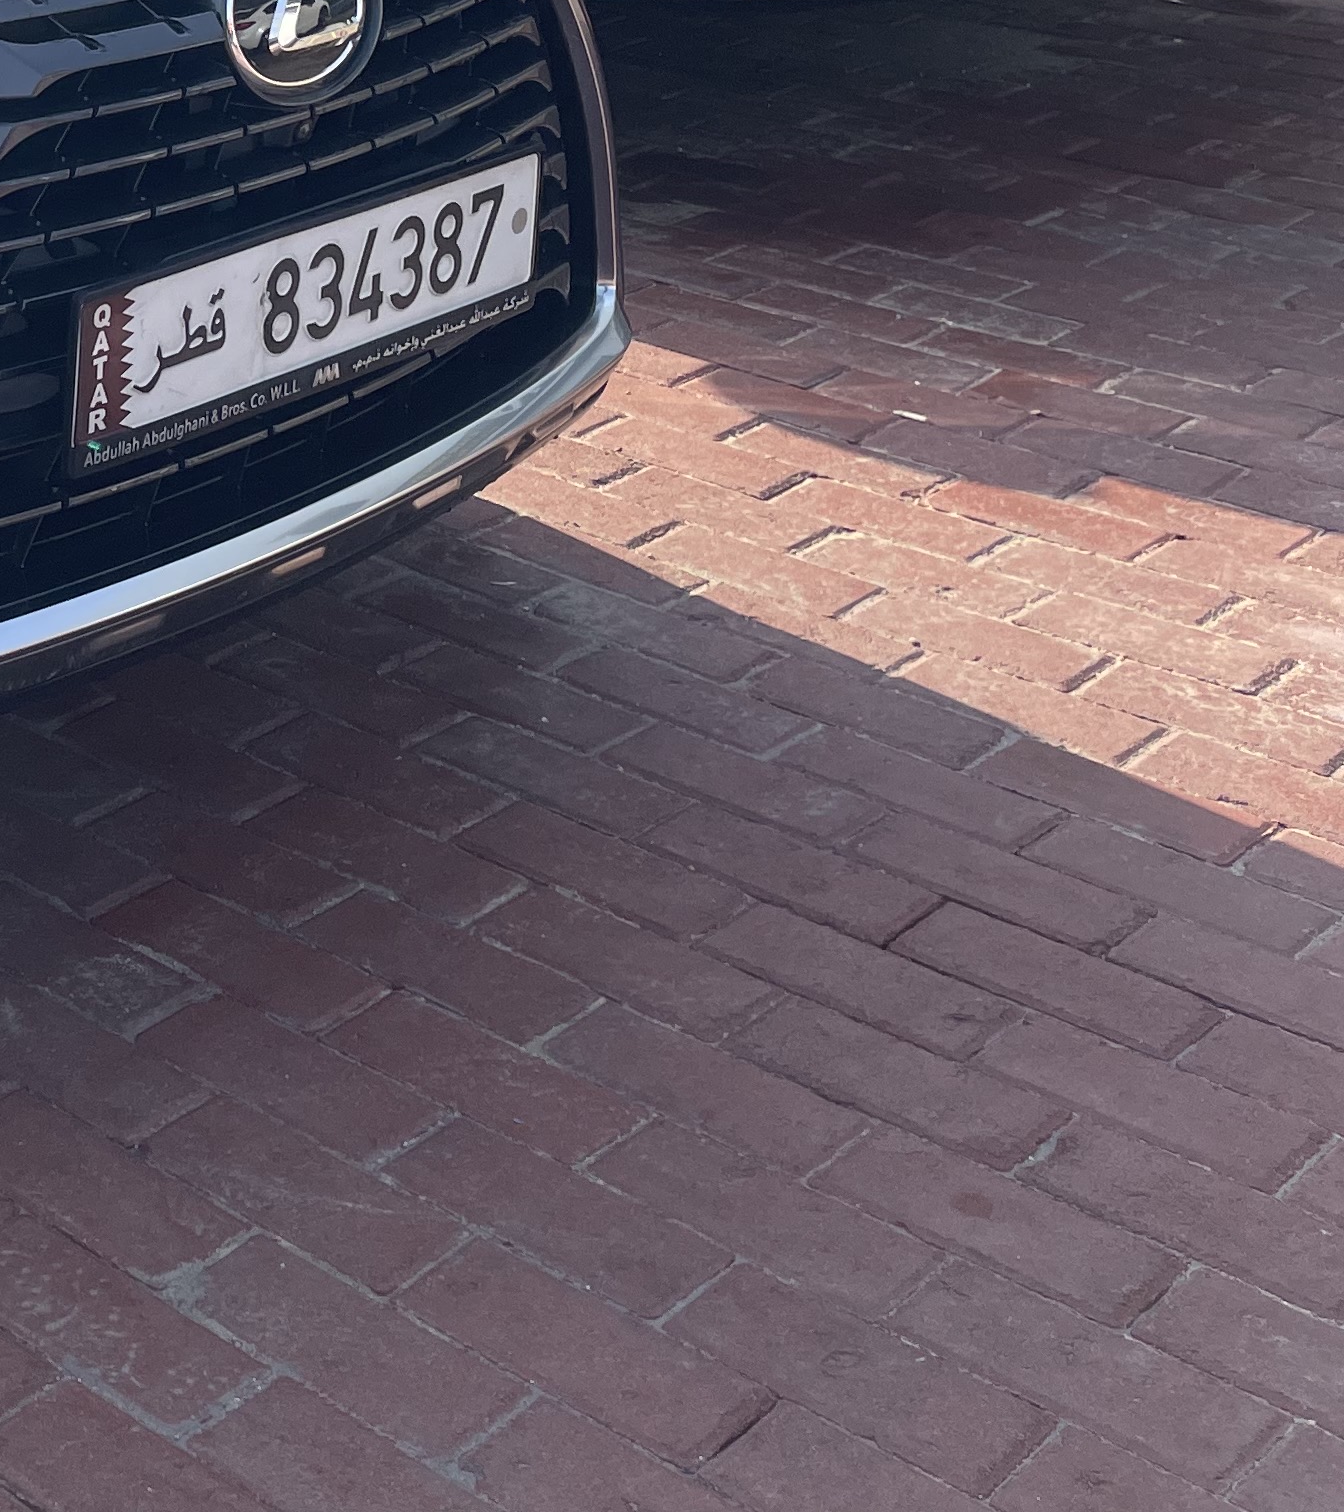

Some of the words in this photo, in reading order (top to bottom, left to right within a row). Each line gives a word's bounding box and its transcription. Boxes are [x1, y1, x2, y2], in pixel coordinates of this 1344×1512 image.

[263, 183, 504, 354] 834387
[503, 290, 530, 311] شركة
[87, 303, 112, 434] QATAR
[133, 288, 226, 393] قطر
[83, 437, 140, 468] Abdullah
[142, 410, 210, 448] Abdulghani
[211, 406, 219, 424] &
